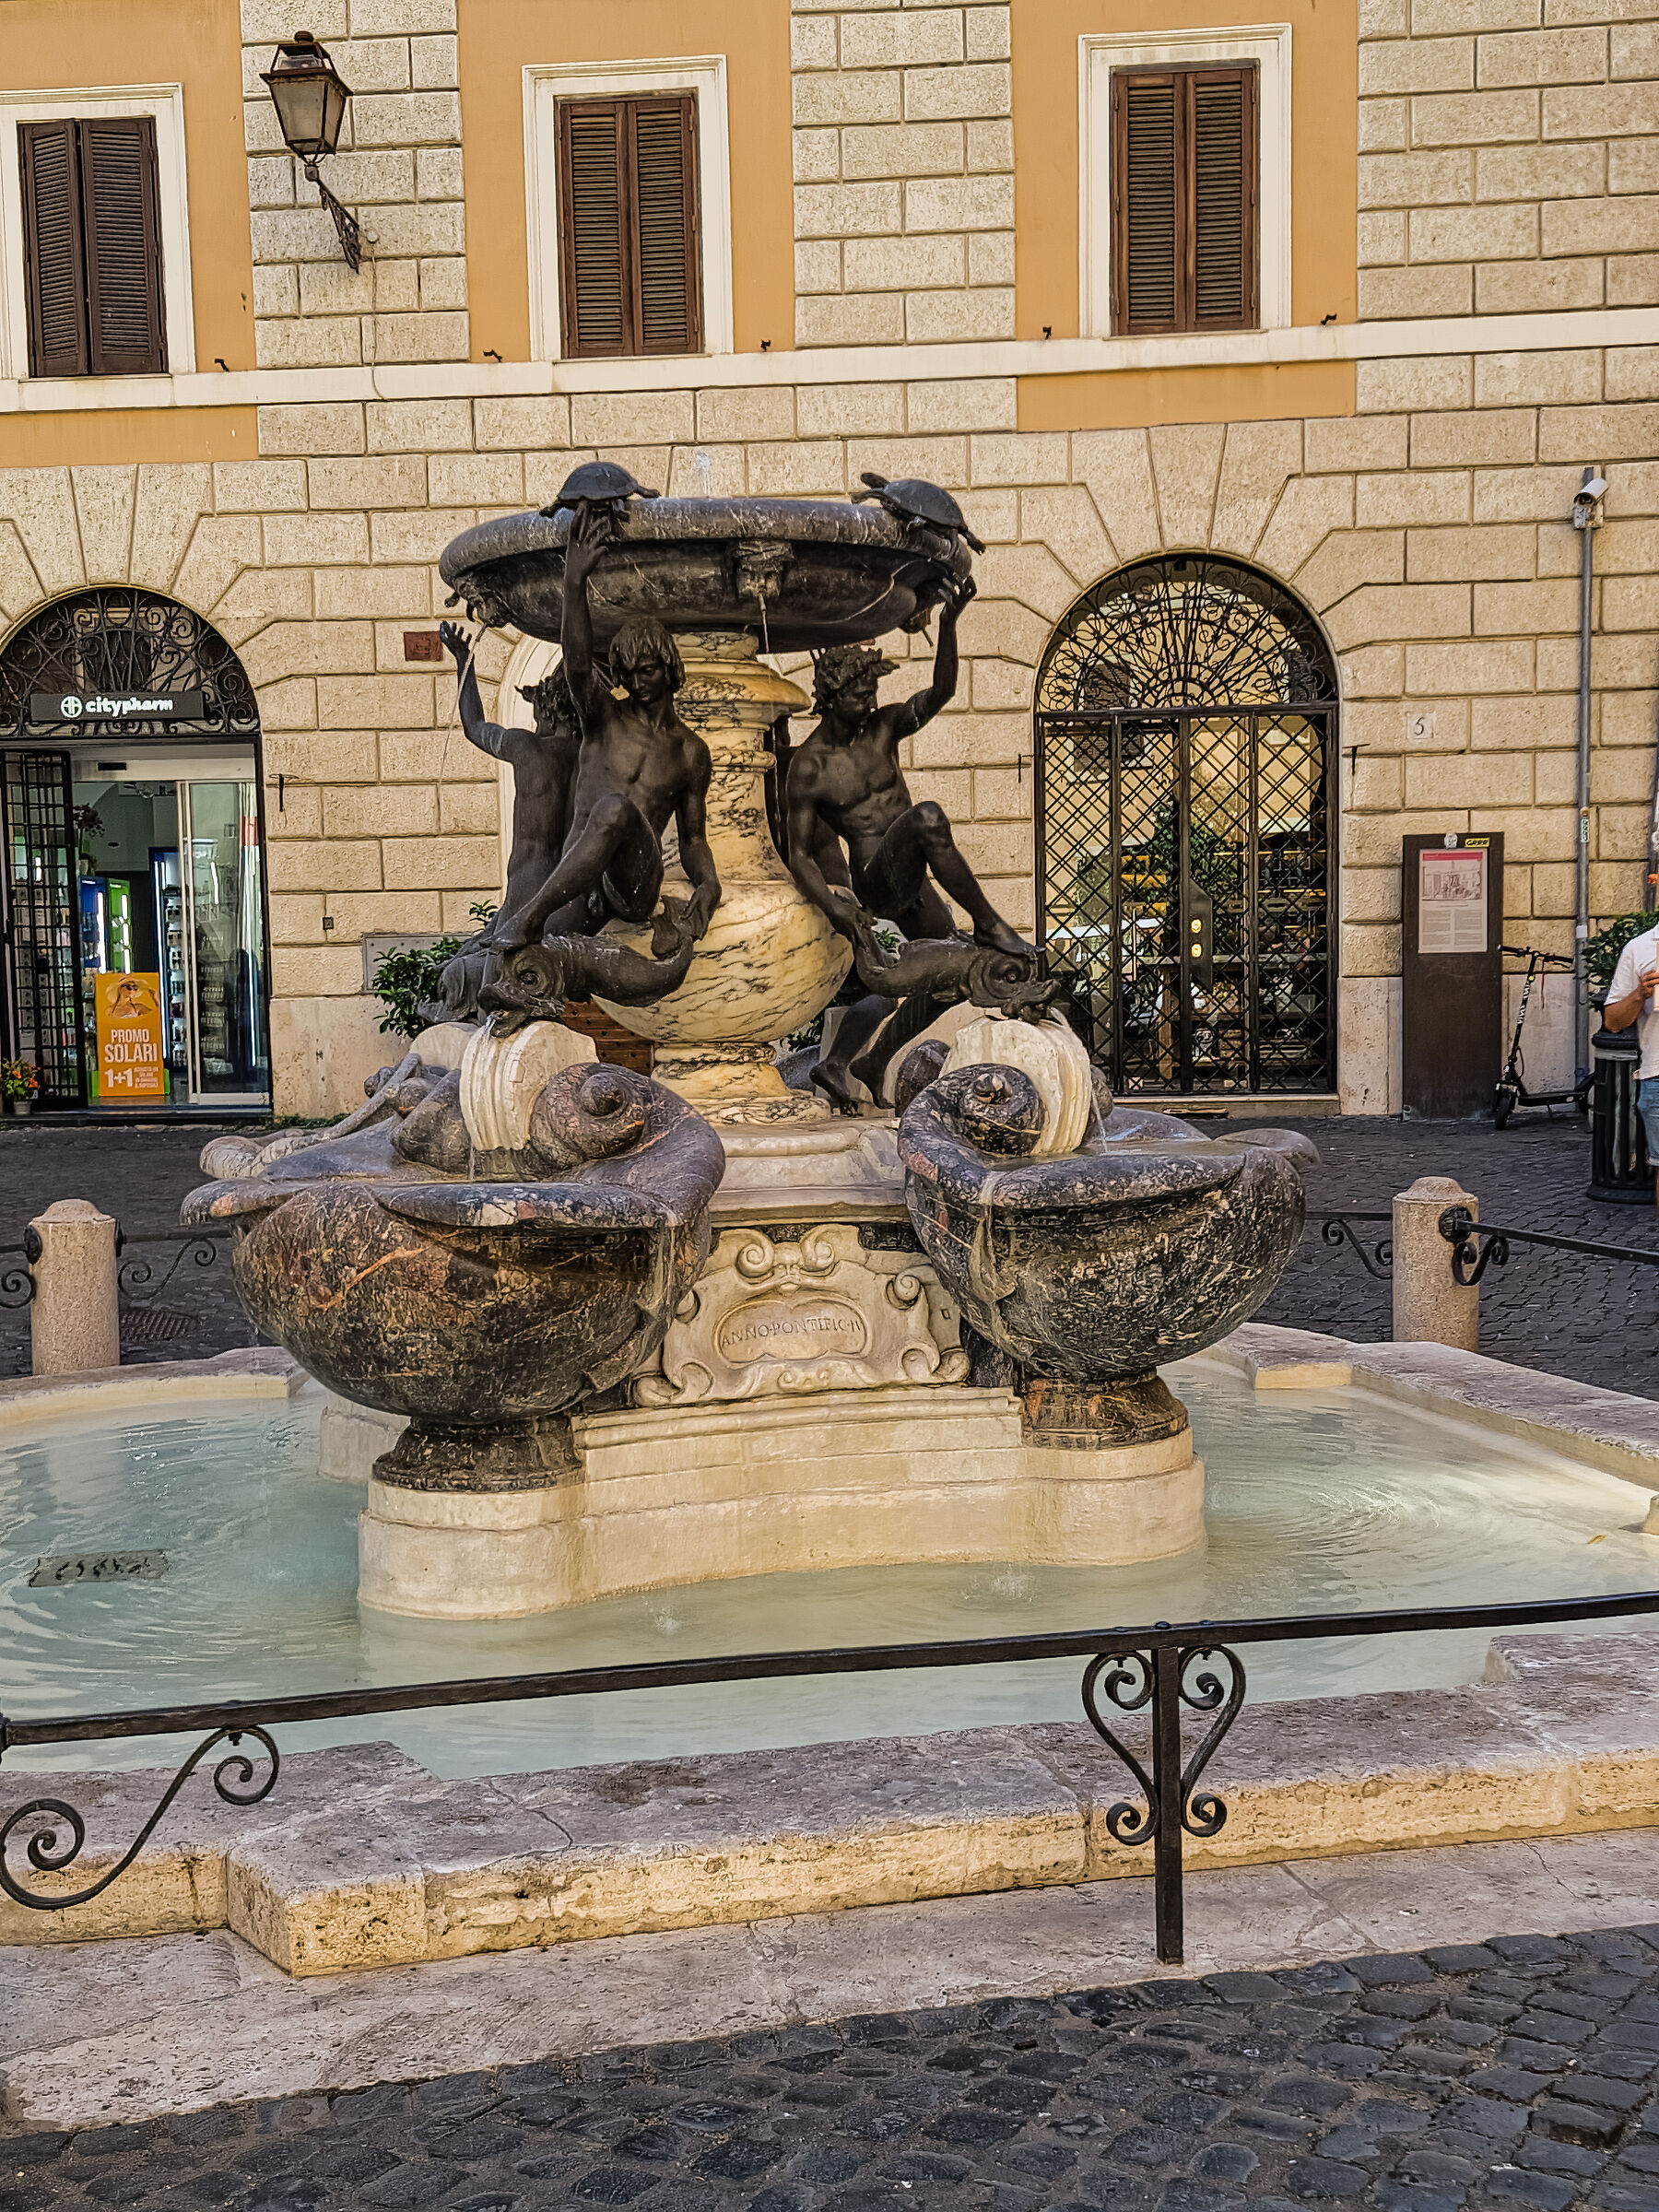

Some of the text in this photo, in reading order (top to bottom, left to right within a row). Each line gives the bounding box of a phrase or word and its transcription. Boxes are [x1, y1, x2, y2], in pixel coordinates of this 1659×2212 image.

[85, 696, 173, 717] citypharm
[1414, 716, 1425, 735] 5
[111, 1028, 150, 1043] PROMO
[104, 1042, 158, 1063] SOLARI
[104, 1068, 133, 1088] 1+1
